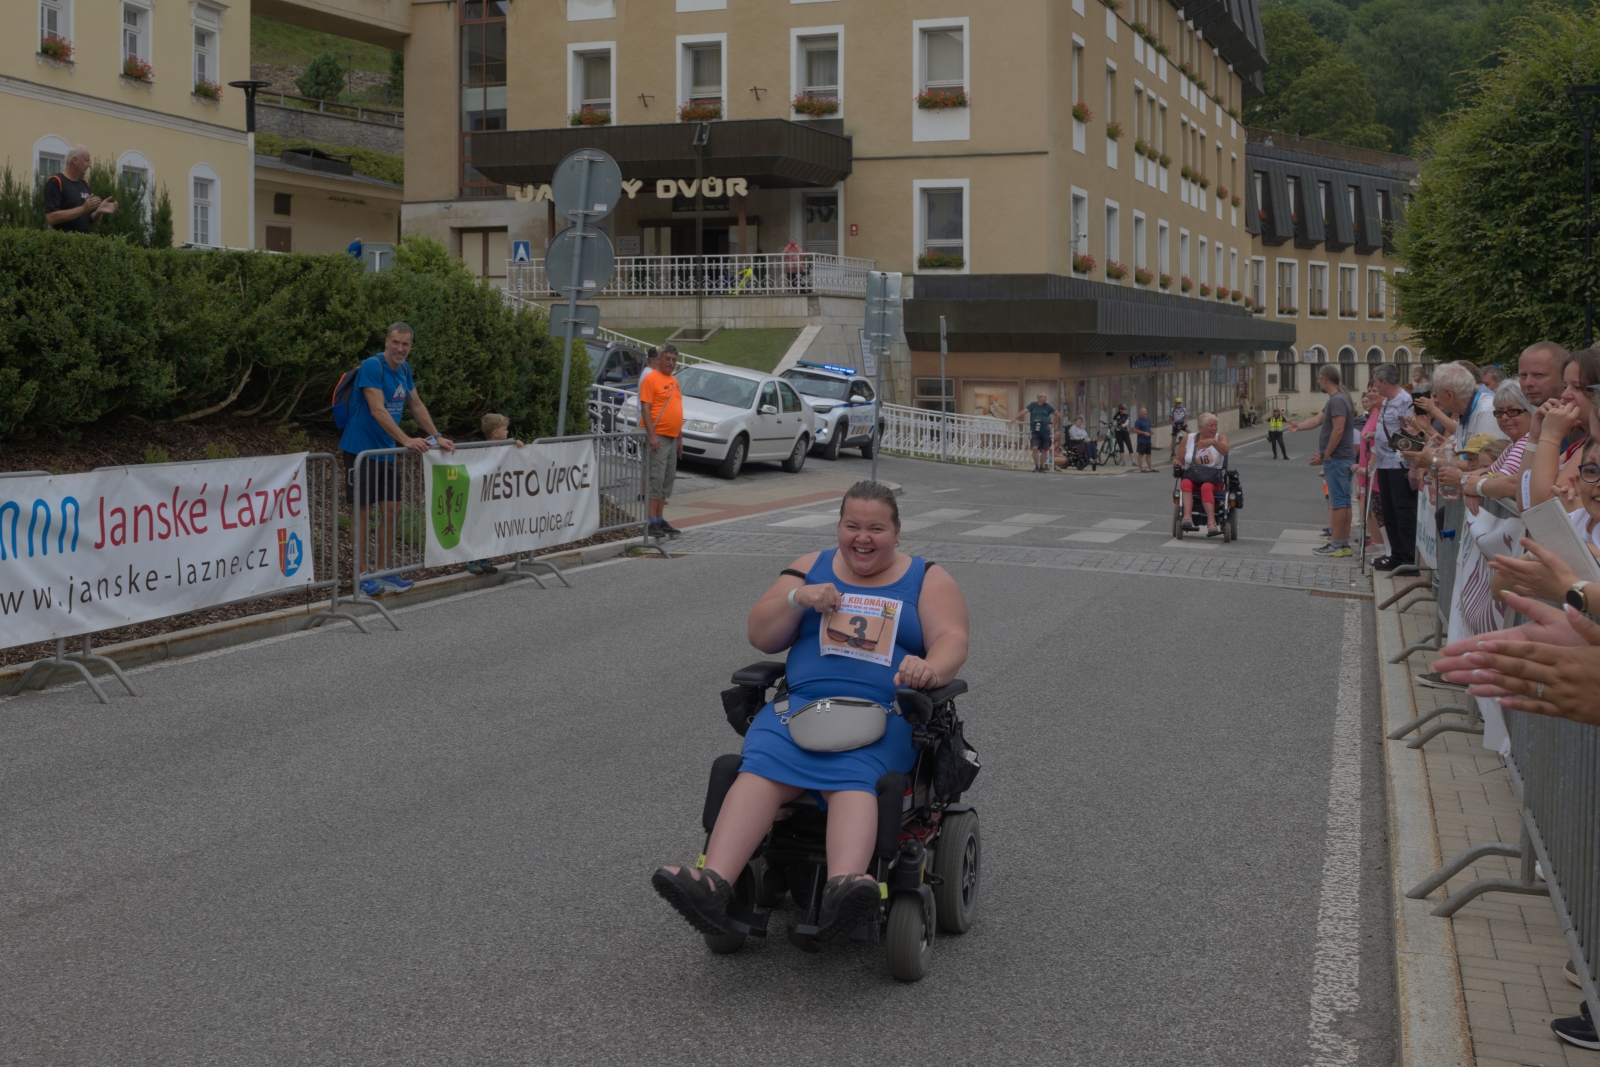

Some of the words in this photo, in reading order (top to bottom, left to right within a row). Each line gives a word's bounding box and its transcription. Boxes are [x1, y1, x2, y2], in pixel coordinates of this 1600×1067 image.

[514, 178, 643, 203] JAÝ
[656, 176, 748, 199] DVŮR
[1199, 455, 1210, 465] 18
[546, 461, 590, 494] ÚPICE
[94, 483, 208, 549] Janské
[494, 511, 574, 538] www.upice.cz
[848, 596, 898, 609] KOLONÁDOU
[847, 616, 867, 648] 3
